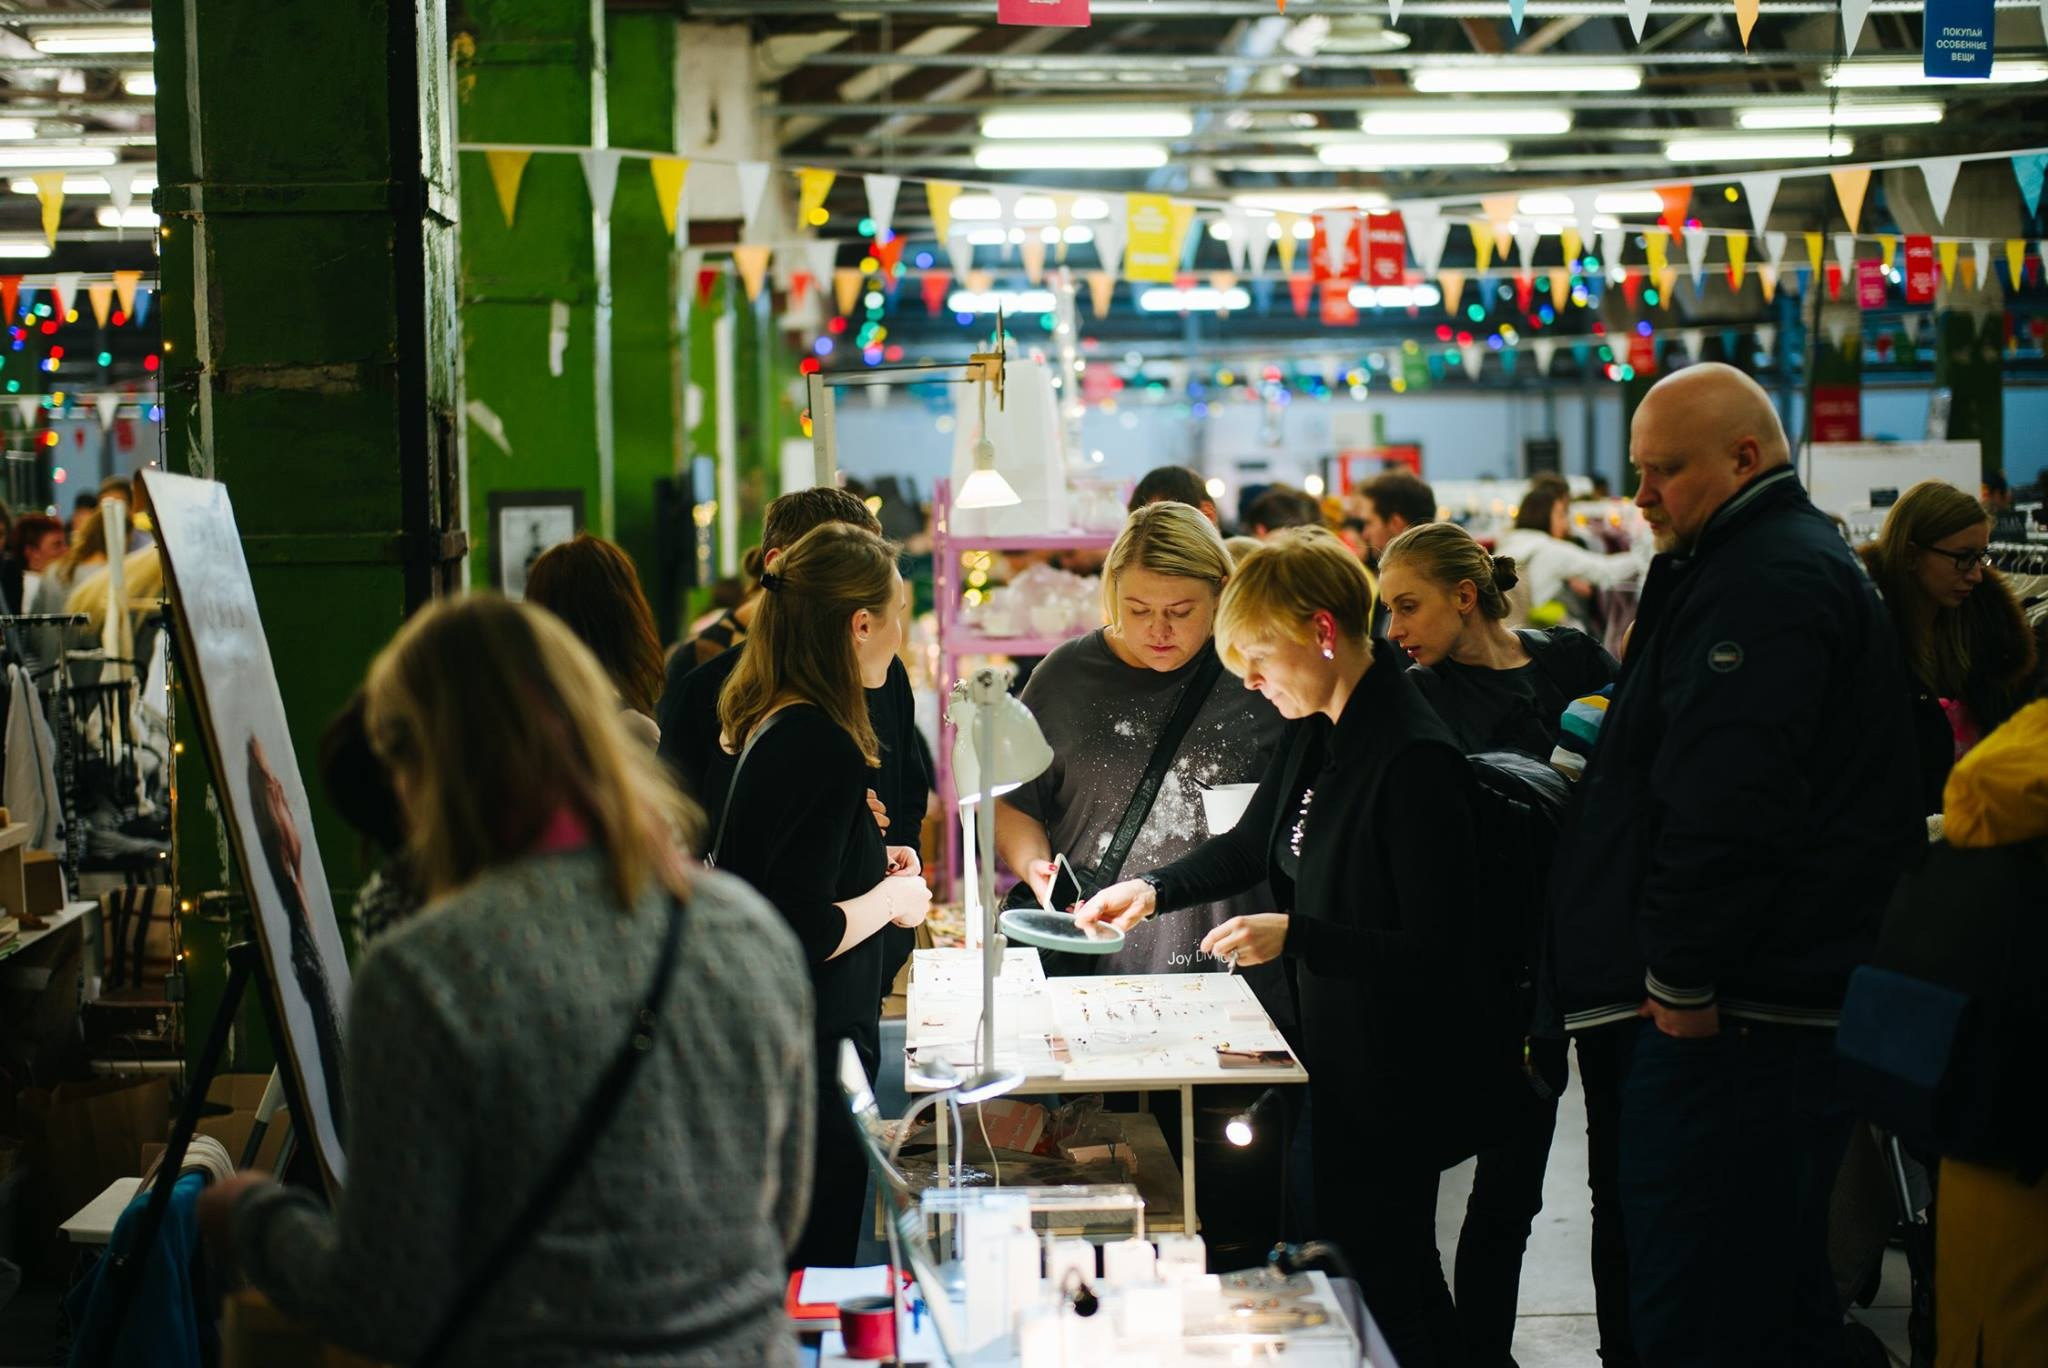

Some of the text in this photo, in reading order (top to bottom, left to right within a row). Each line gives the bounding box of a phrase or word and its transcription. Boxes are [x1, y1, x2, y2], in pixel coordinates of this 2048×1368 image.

[1943, 27, 1982, 37] ПОКУПАЙ
[1936, 40, 1987, 50] ОСОБЕННЫЕ
[1951, 52, 1975, 62] ВЕЩИ
[1167, 951, 1192, 966] Joy
